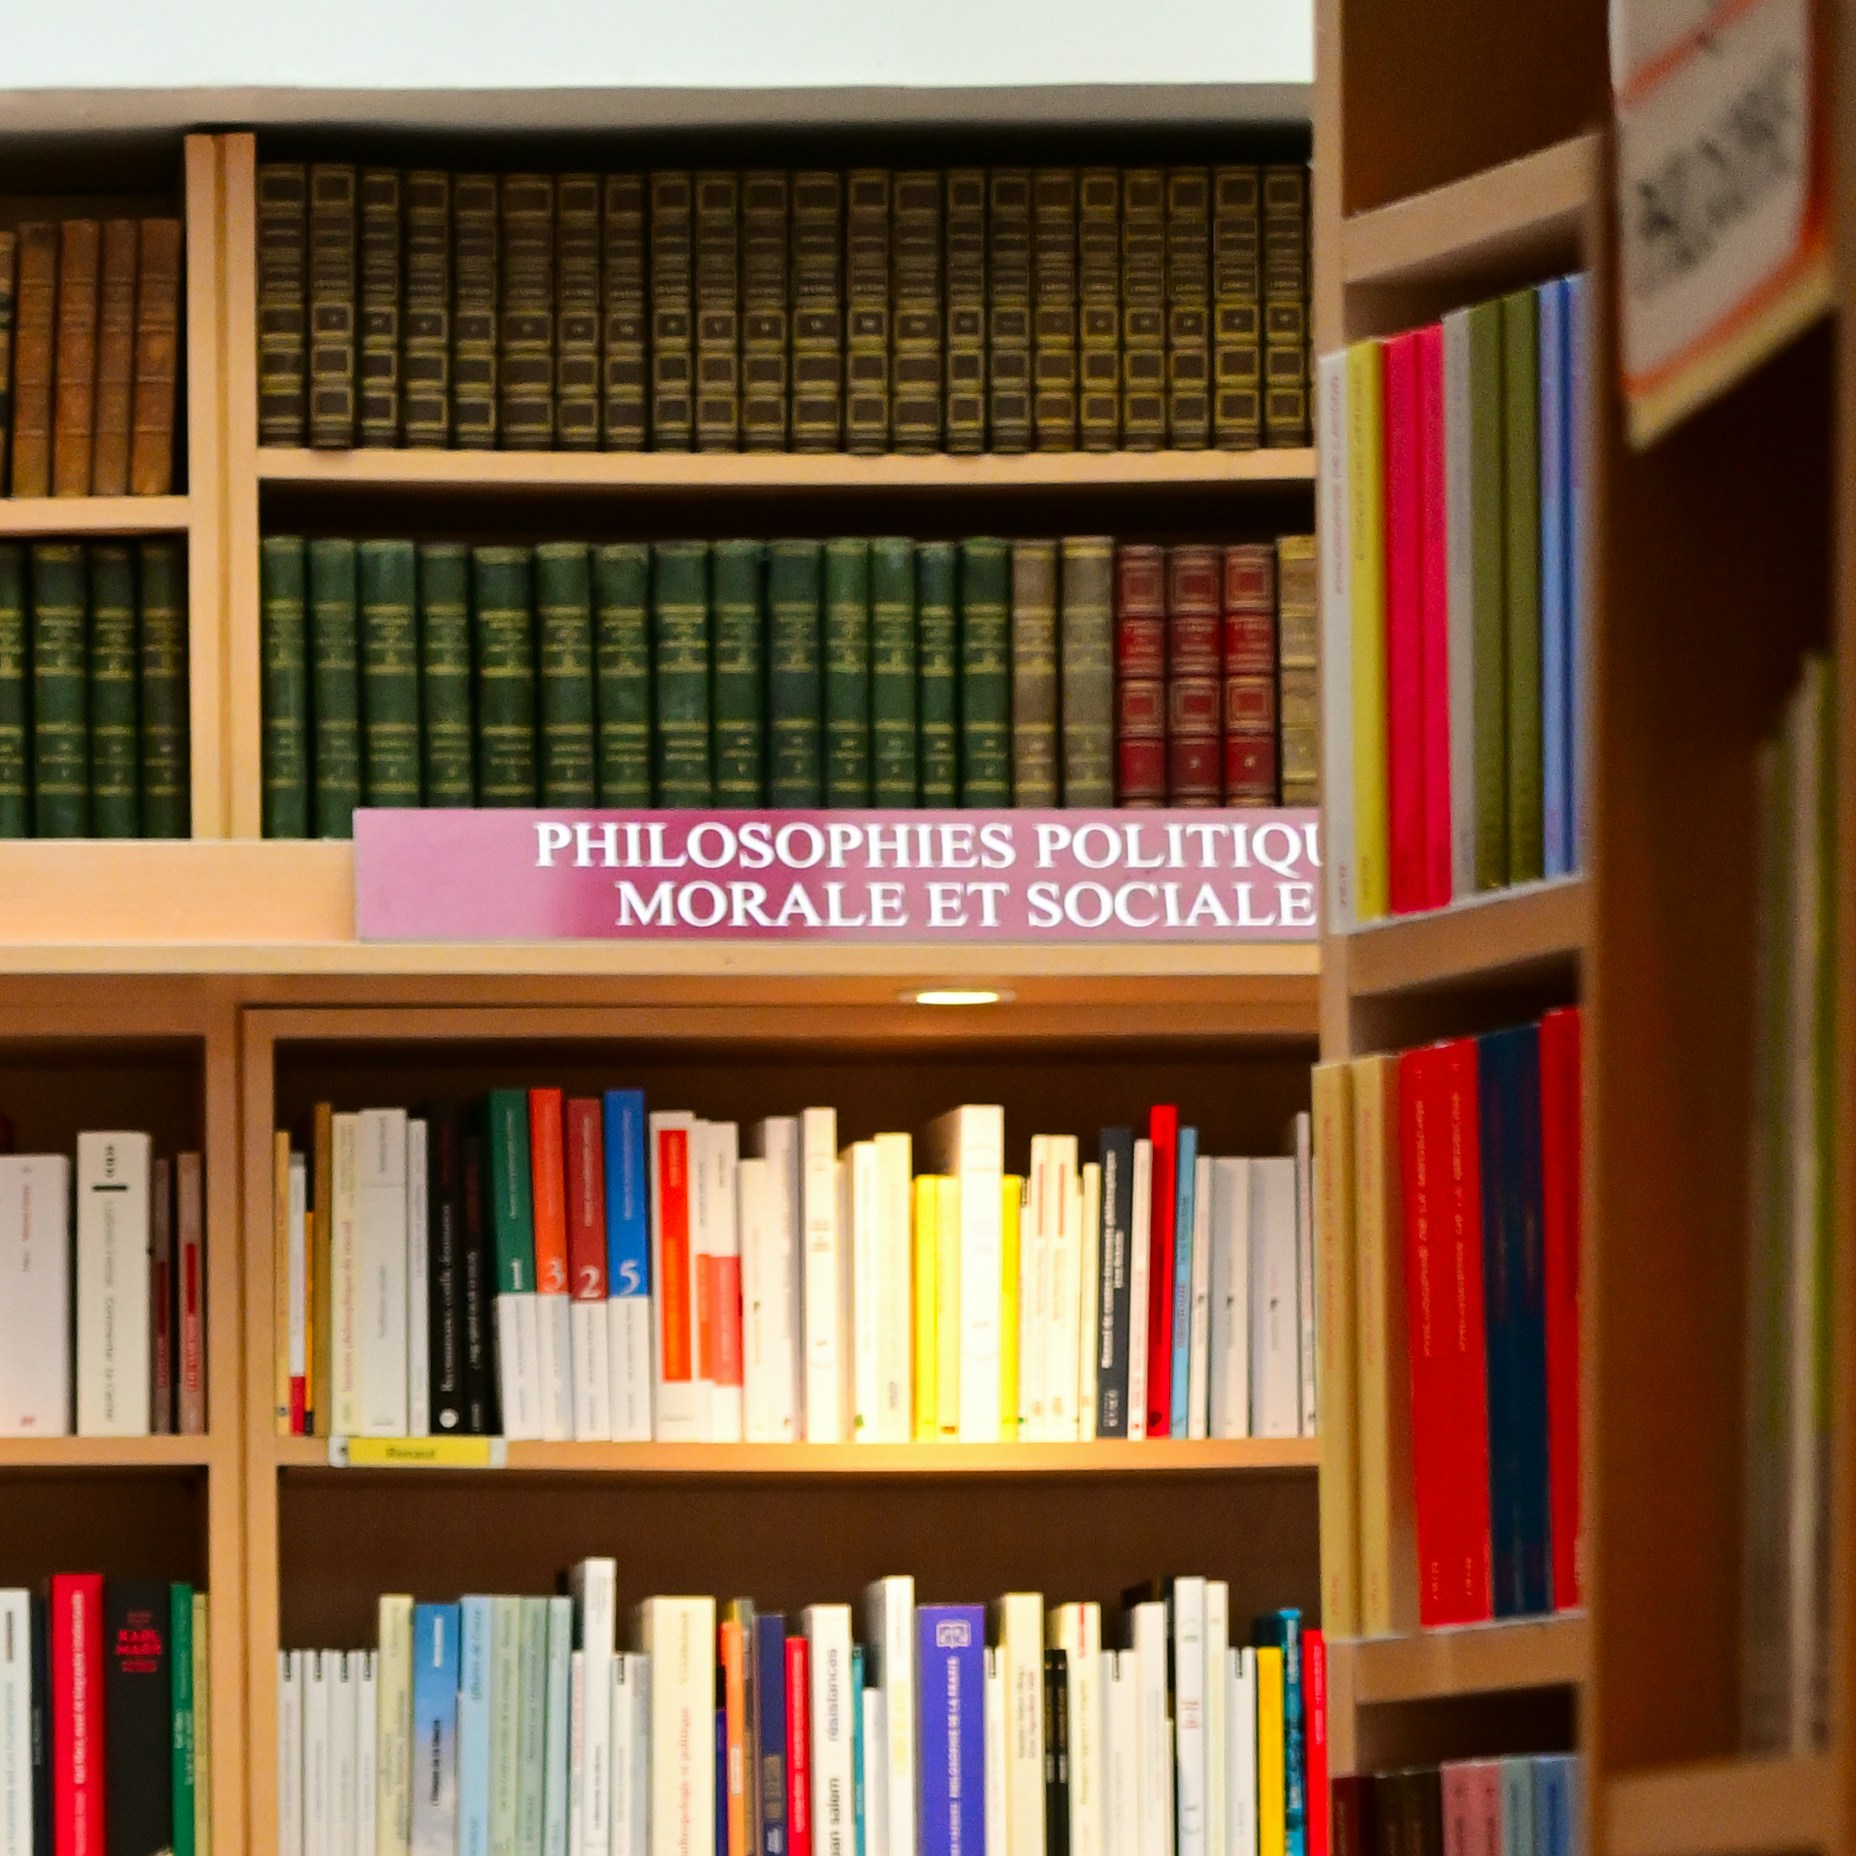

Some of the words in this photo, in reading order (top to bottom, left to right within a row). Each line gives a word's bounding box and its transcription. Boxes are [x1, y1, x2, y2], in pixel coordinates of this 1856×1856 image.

[535, 821, 1015, 870] PHILOSOPHIES
[614, 880, 909, 929] MORALE
[926, 880, 1008, 929] ET
[1027, 880, 1317, 928] SOCIALE
